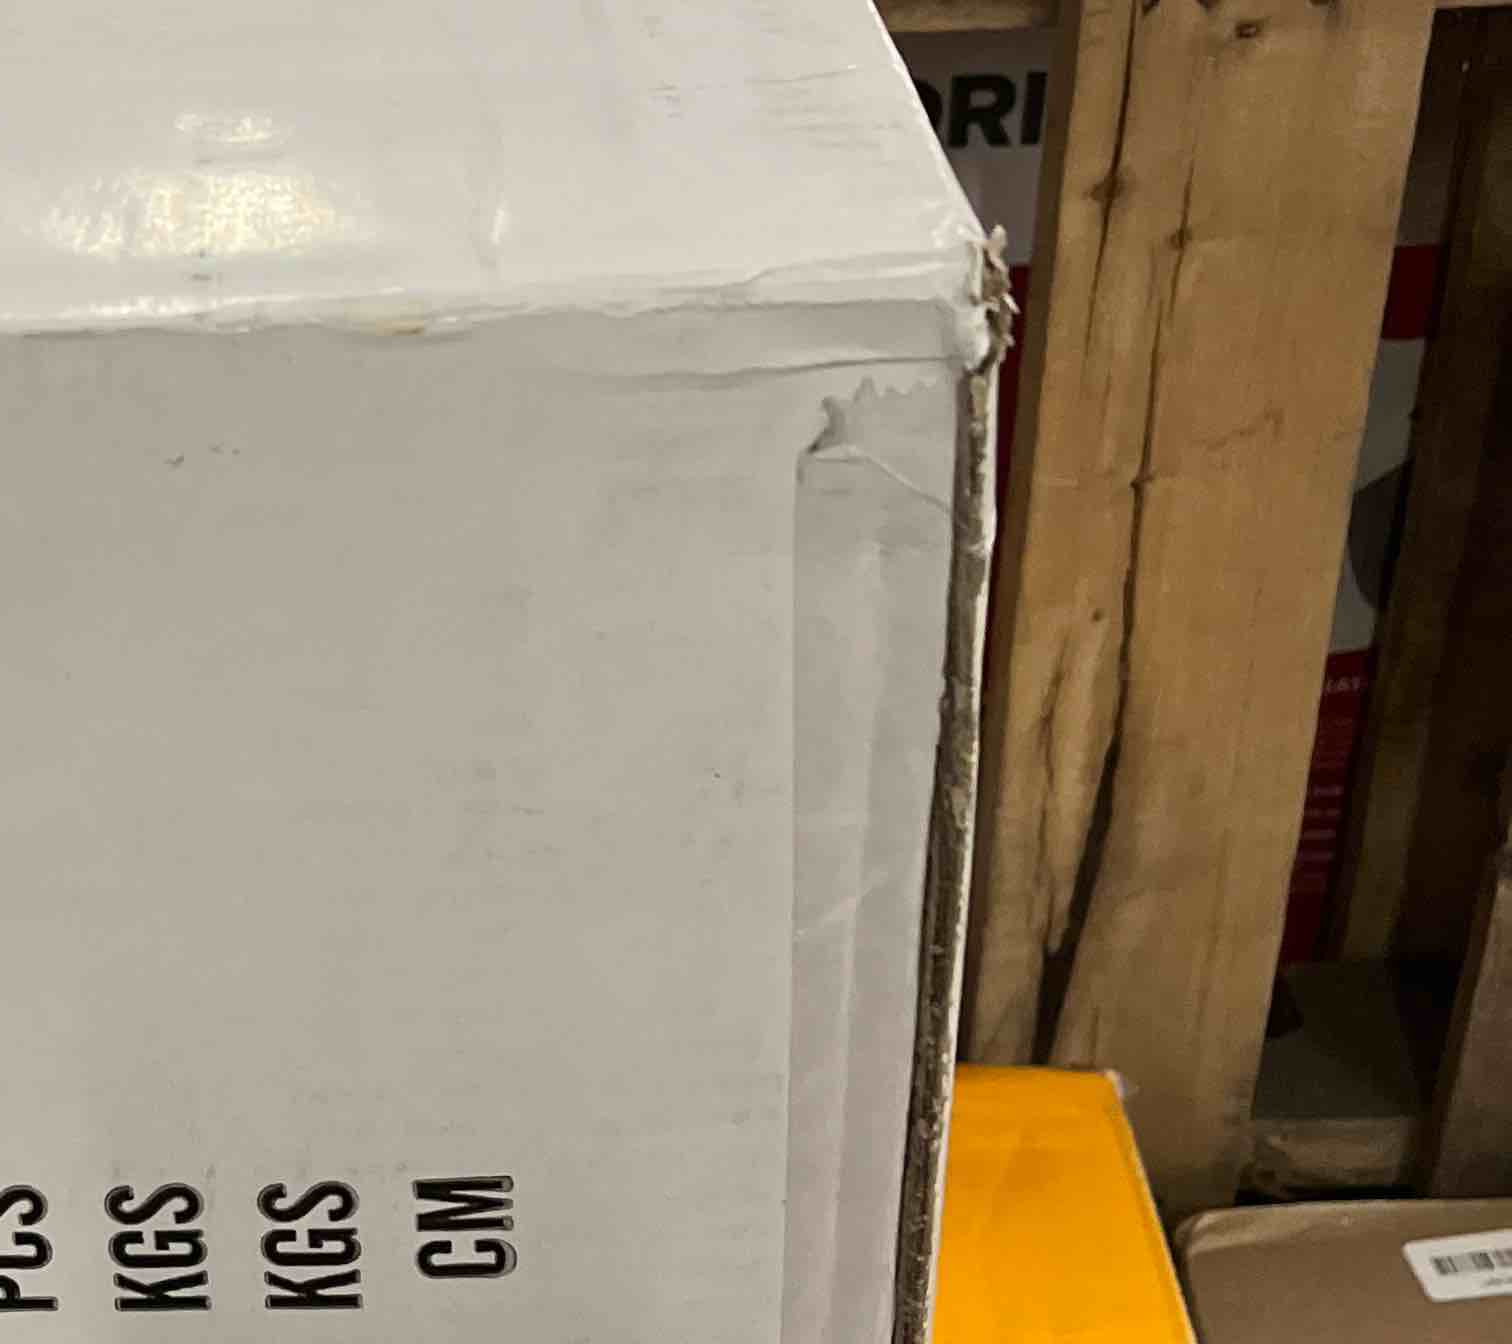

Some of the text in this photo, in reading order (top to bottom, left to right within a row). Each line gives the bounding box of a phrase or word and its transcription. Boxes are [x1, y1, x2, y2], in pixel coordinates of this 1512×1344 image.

[104, 1180, 212, 1313] KGS
[256, 1179, 364, 1311] KGS
[413, 1175, 518, 1280] CM
